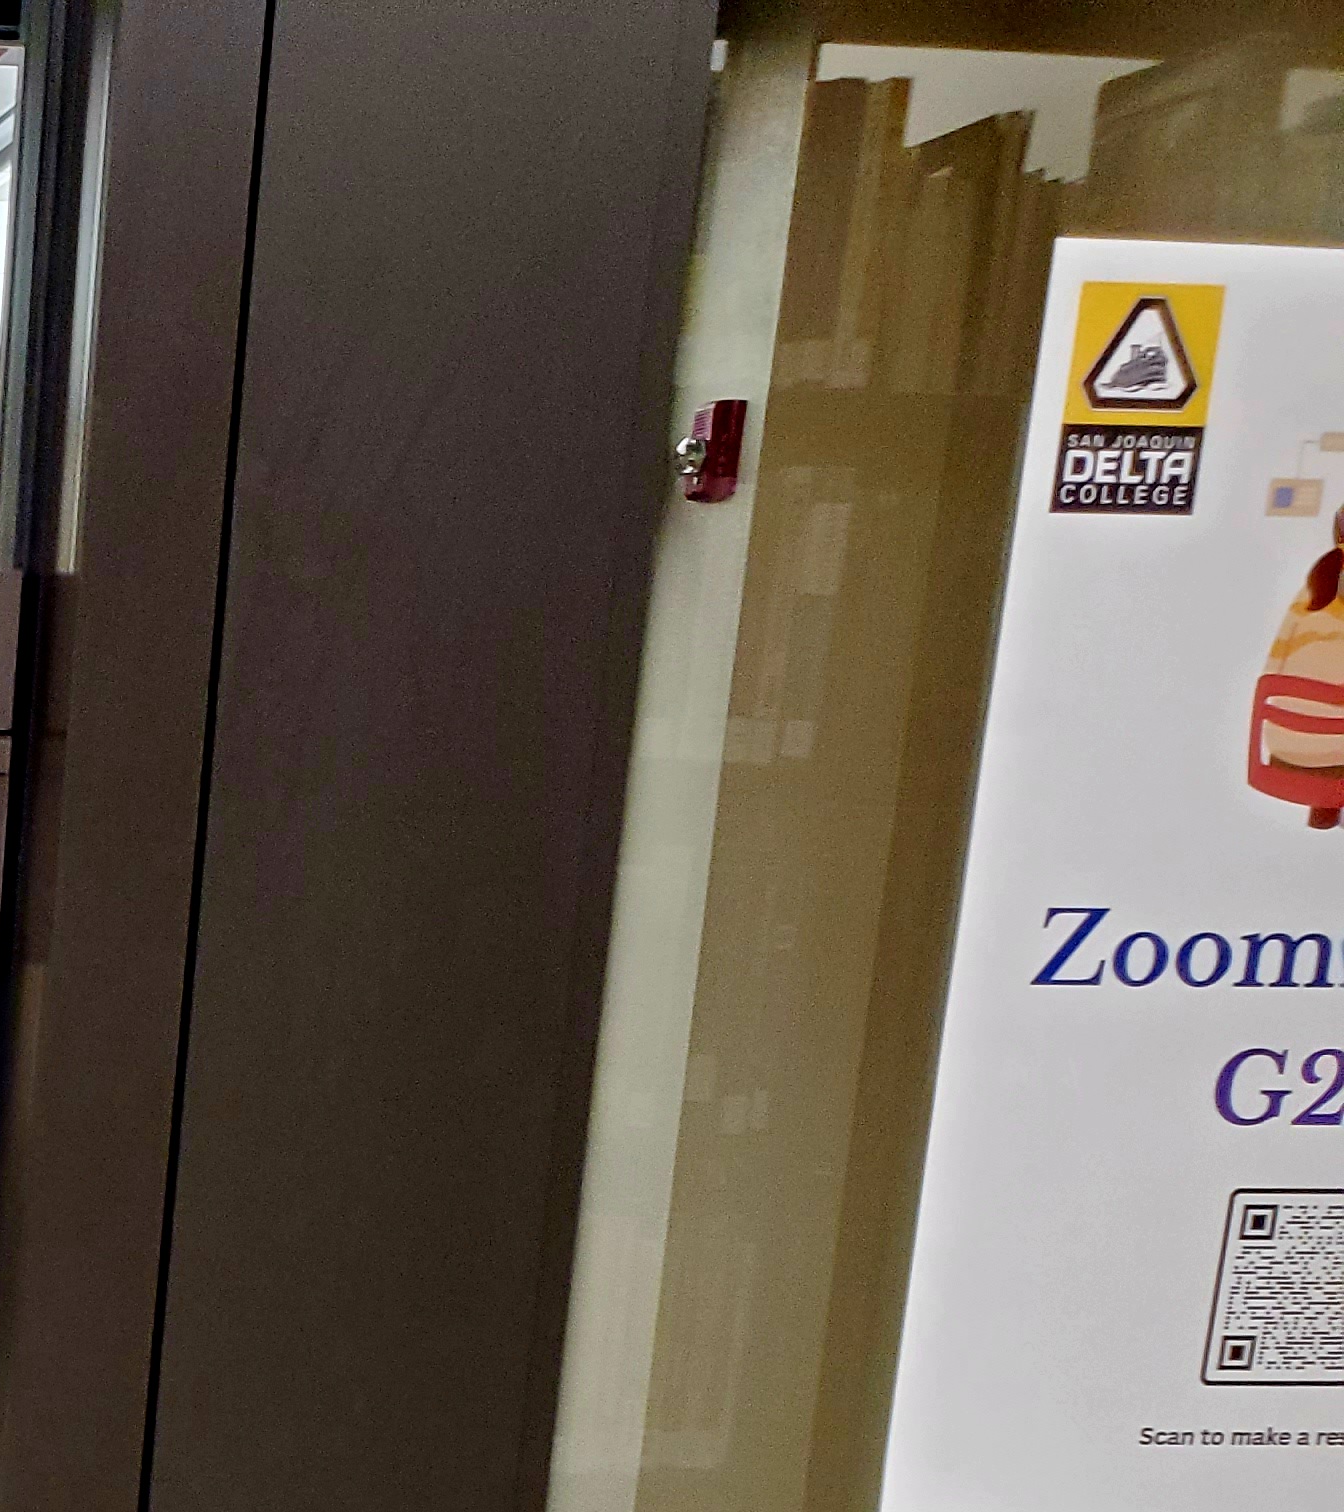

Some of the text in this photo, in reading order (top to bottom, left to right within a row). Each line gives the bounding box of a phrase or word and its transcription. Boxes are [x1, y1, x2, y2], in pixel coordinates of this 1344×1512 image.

[1067, 434, 1196, 449] SAN JOAQUIN
[1062, 449, 1194, 484] DELTA
[1059, 483, 1189, 506] COLLEGE
[1030, 907, 1344, 988] Zoom
[1215, 1047, 1344, 1126] G2
[1139, 1427, 1195, 1446] Scan
[1201, 1429, 1225, 1446] to
[1230, 1426, 1293, 1446] make
[1297, 1431, 1310, 1446] a
